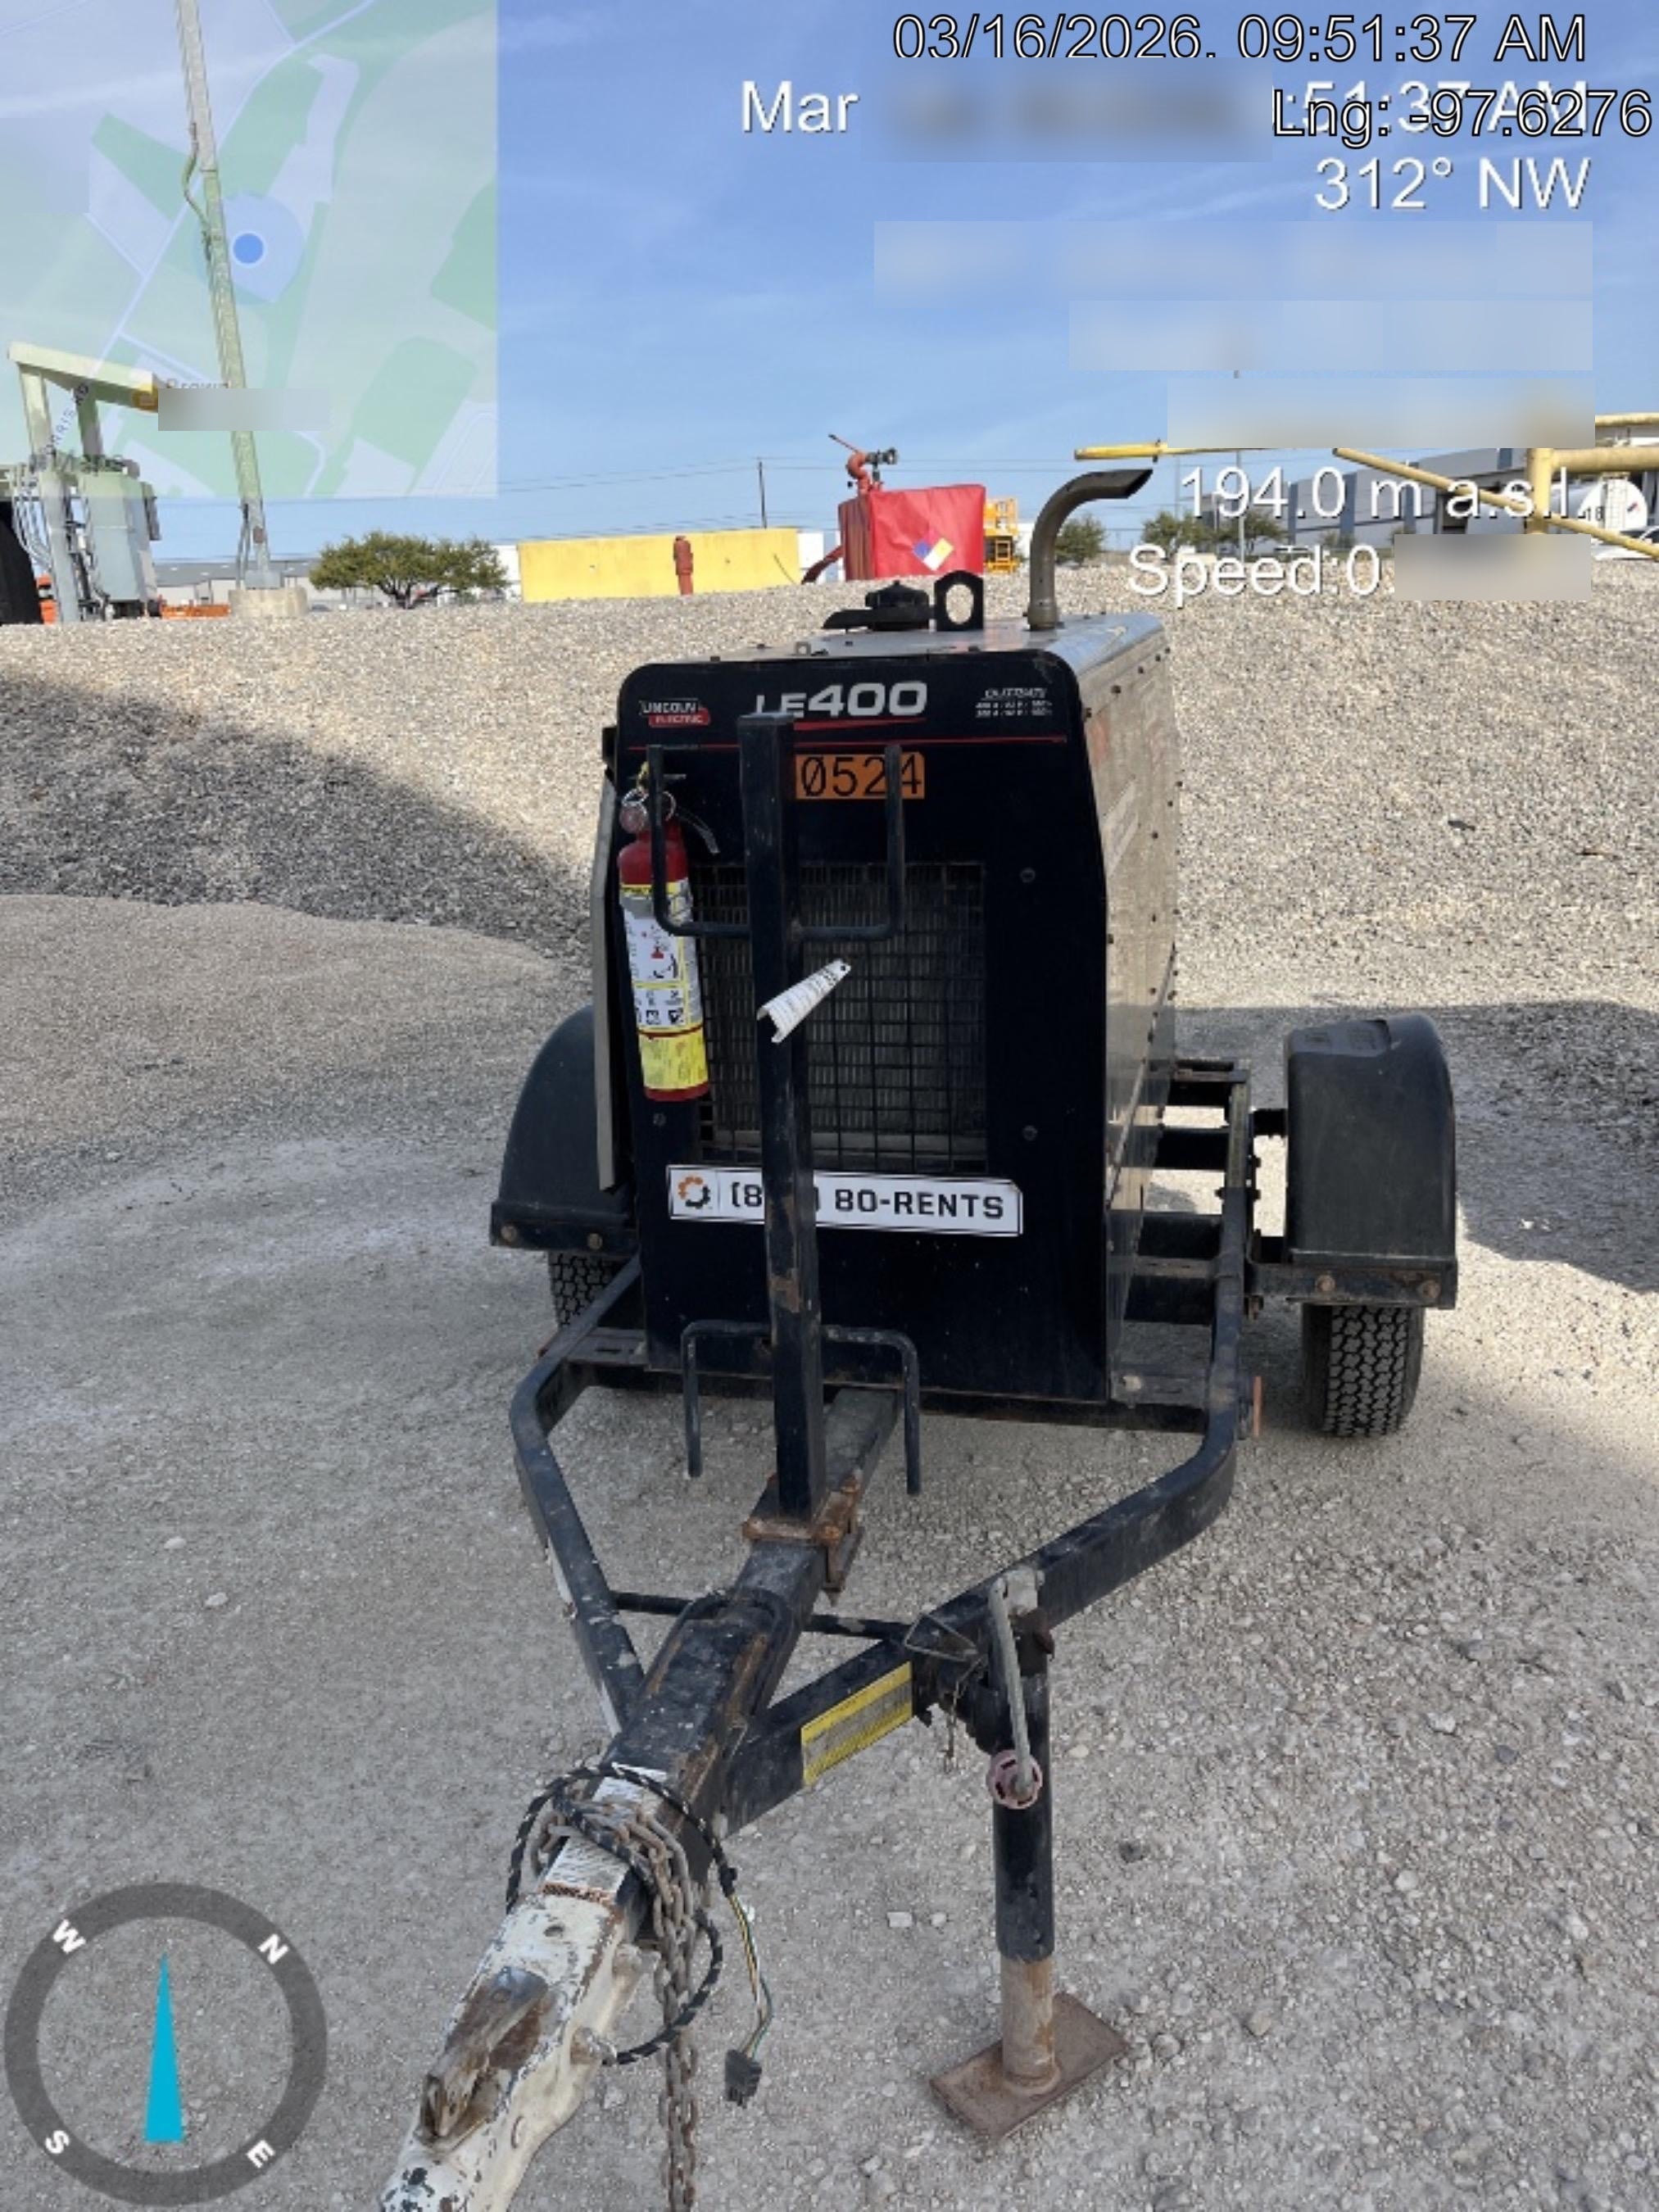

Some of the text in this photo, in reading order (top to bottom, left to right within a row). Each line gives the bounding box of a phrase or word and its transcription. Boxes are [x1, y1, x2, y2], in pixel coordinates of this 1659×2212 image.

[754, 681, 928, 718] LE400
[800, 755, 922, 797] 0524
[835, 1188, 1004, 1221] 80-RENTS
